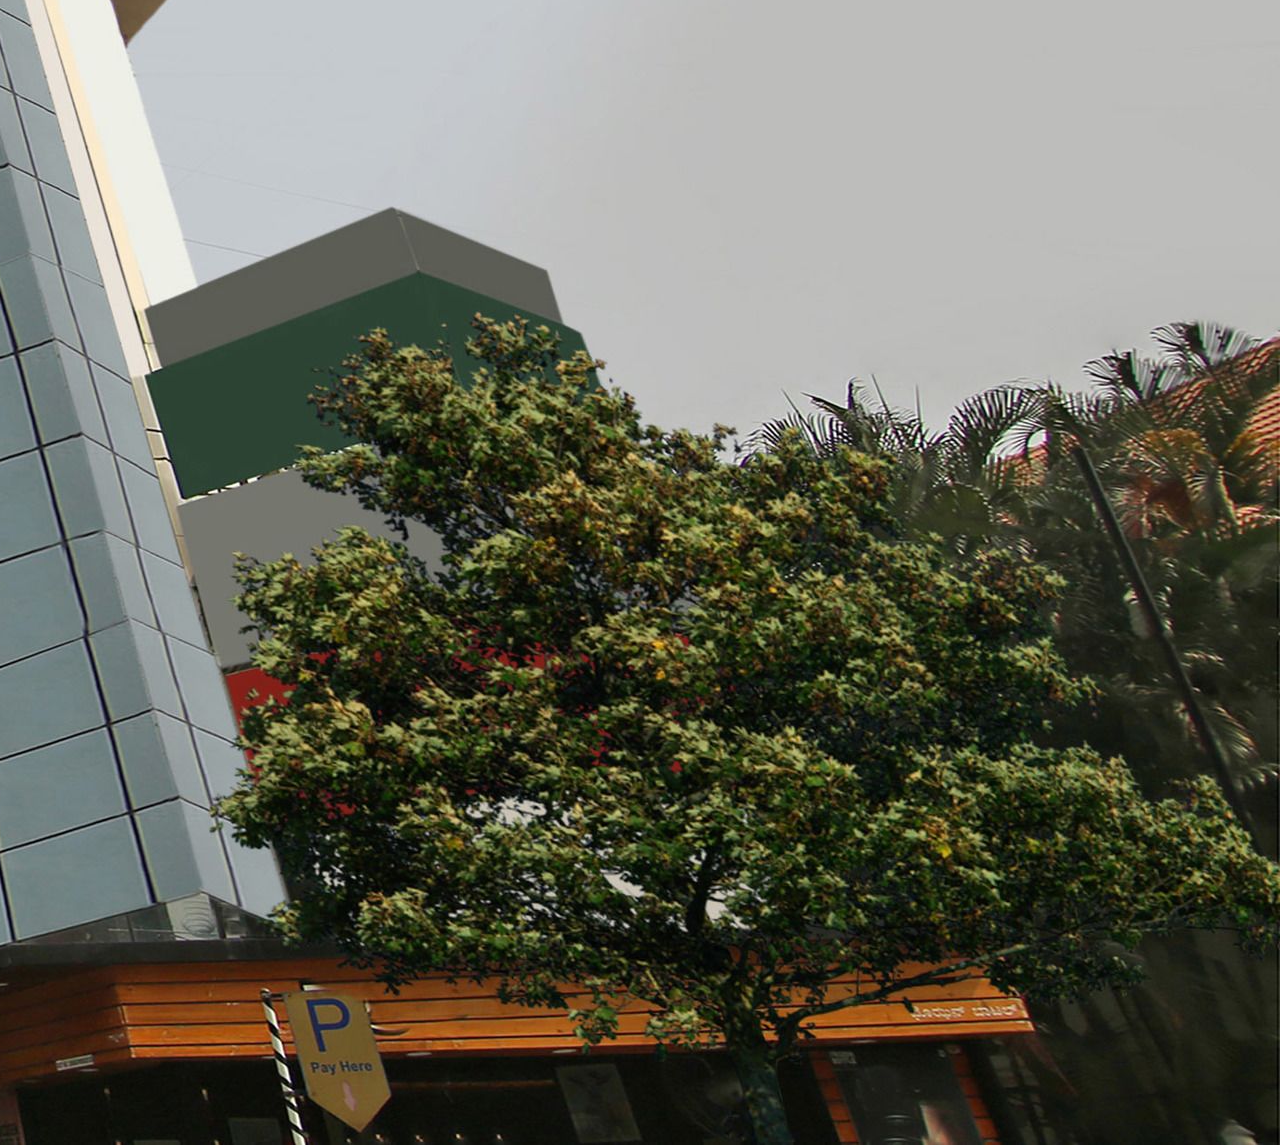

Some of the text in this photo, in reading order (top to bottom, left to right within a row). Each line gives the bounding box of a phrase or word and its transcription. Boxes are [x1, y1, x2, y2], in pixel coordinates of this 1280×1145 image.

[306, 998, 351, 1053] P
[310, 1060, 374, 1075] Pay Here
